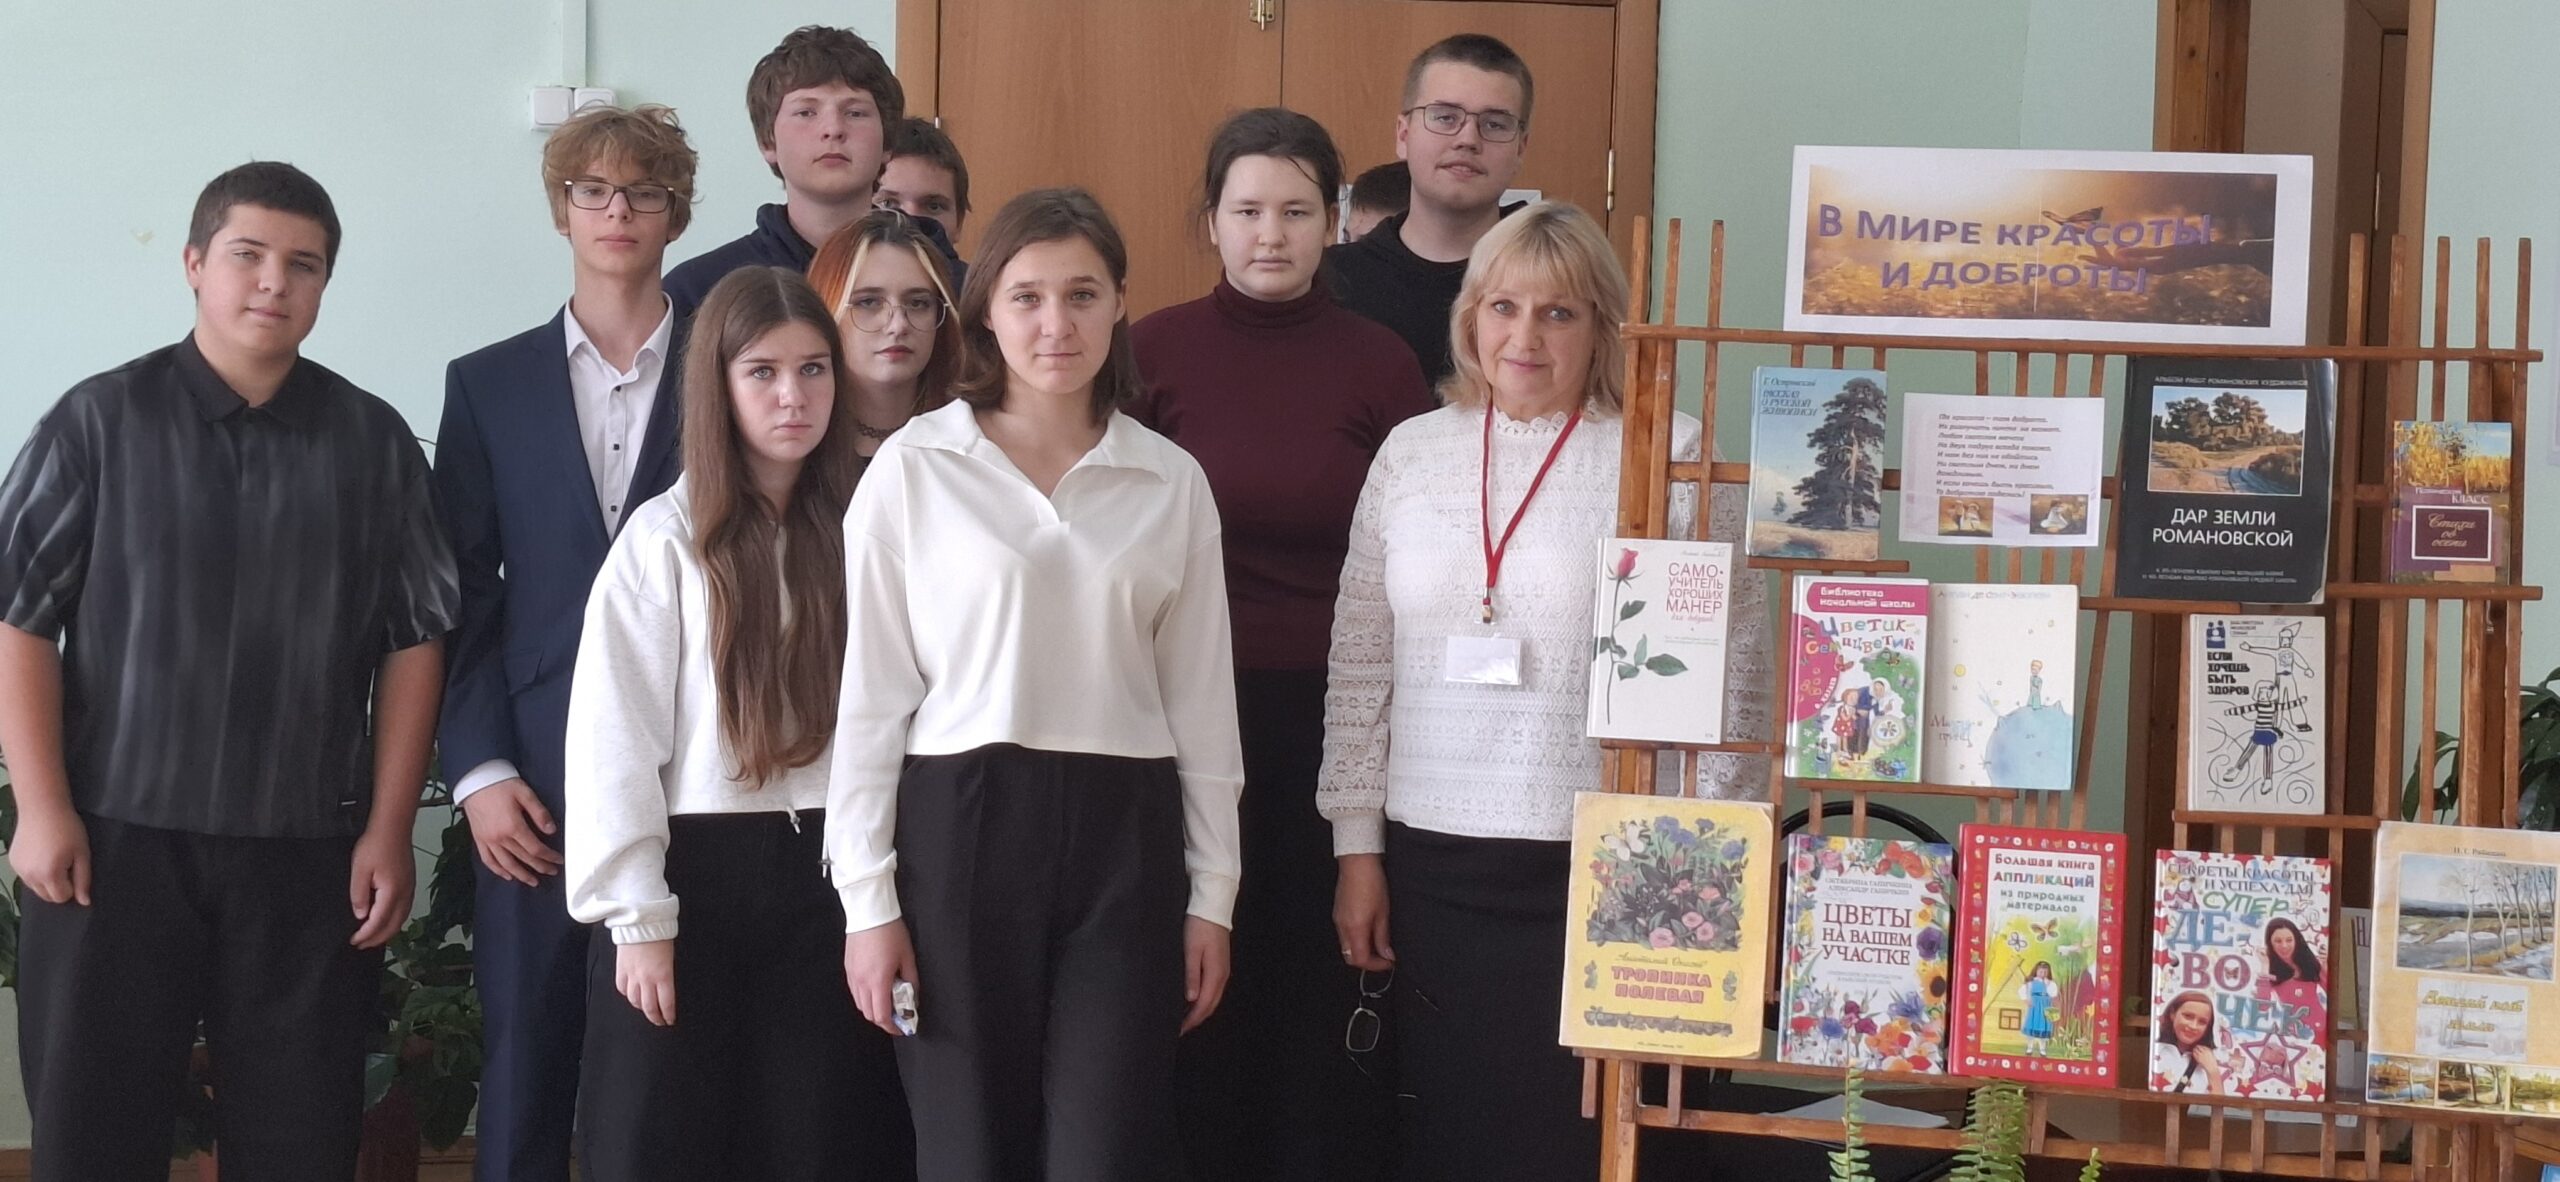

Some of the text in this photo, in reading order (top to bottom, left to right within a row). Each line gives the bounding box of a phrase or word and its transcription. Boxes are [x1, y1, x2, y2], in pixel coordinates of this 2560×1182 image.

[1819, 204, 2214, 248] В МИРЕ КРАСОТЫ
[1881, 261, 2147, 295] И ДОБРОТЫ
[2452, 493, 2490, 505] КЛАСС
[2170, 507, 2276, 527] ДАР ЗЕМЛИ
[2428, 512, 2476, 532] Стихи
[2152, 527, 2294, 548] РОМАНОВСКОЙ
[1669, 577, 1724, 590] УЧИТЕЛЬ
[1820, 586, 1884, 598] Библиотека
[1669, 588, 1725, 600] ХОРОШИХ
[1666, 598, 1723, 615] МАНЕР
[1819, 598, 1915, 609] начальной школы
[1819, 616, 1916, 637] Цветик-
[2207, 651, 2233, 661] ЕСЛИ
[2207, 663, 2250, 673] ХОЧЕШЬ
[2207, 674, 2237, 684] БЫТЬ
[2207, 685, 2250, 695] ЗДОРОВ
[1995, 853, 2096, 871] Большая книга
[1993, 871, 2095, 889] АППЛИКАЦИЙ
[2167, 863, 2315, 882] СЕКРЕТЫ КРАСОТЫ
[2204, 879, 2215, 890] И
[2220, 879, 2280, 894] УСПЕХА
[2000, 889, 2085, 903] из природных
[2203, 891, 2290, 917] СУПЕР
[2006, 901, 2078, 913] материалов
[1822, 903, 1913, 930] ЦВЕТЫ
[1822, 927, 1912, 947] НА ВАШЕМ
[1822, 944, 1911, 966] УЧАСТКЕ
[1611, 965, 1713, 988] ТРОПИНКА
[2180, 952, 2251, 992] ВО
[1615, 983, 1705, 1005] ПОЛЕВАЯ
